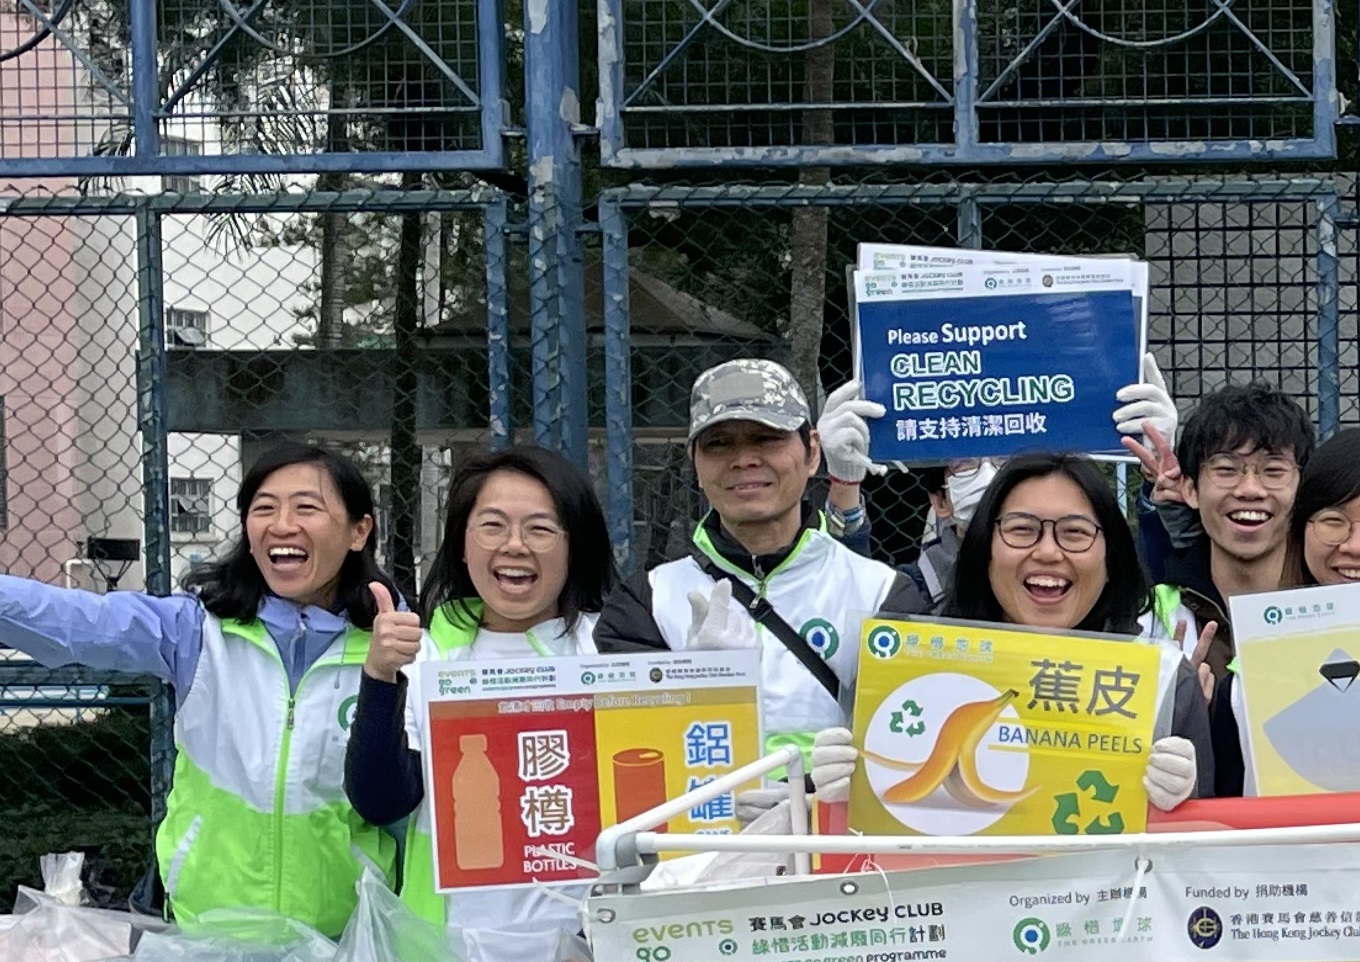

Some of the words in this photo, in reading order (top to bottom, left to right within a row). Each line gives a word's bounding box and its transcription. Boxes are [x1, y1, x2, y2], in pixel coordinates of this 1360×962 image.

[888, 328, 939, 346] Please
[941, 321, 1027, 348] Support
[891, 351, 981, 378] CLEAN
[894, 374, 1074, 410] RECYCLING
[896, 412, 1048, 441] 請支持清潔回收
[1027, 658, 1141, 719] 蕉皮
[998, 725, 1081, 750] BANANA
[1087, 733, 1143, 755] PEELS
[519, 731, 573, 837] 膠樽
[1009, 892, 1072, 908] Organized
[1075, 891, 1091, 906] by
[1185, 886, 1230, 899] Funded
[1233, 886, 1249, 900] by
[894, 902, 944, 919] CLUB
[632, 919, 733, 944] events
[1231, 928, 1249, 940] The
[1252, 928, 1279, 941] Hong
[1281, 927, 1306, 940] Kong
[1308, 927, 1341, 940] Jockey
